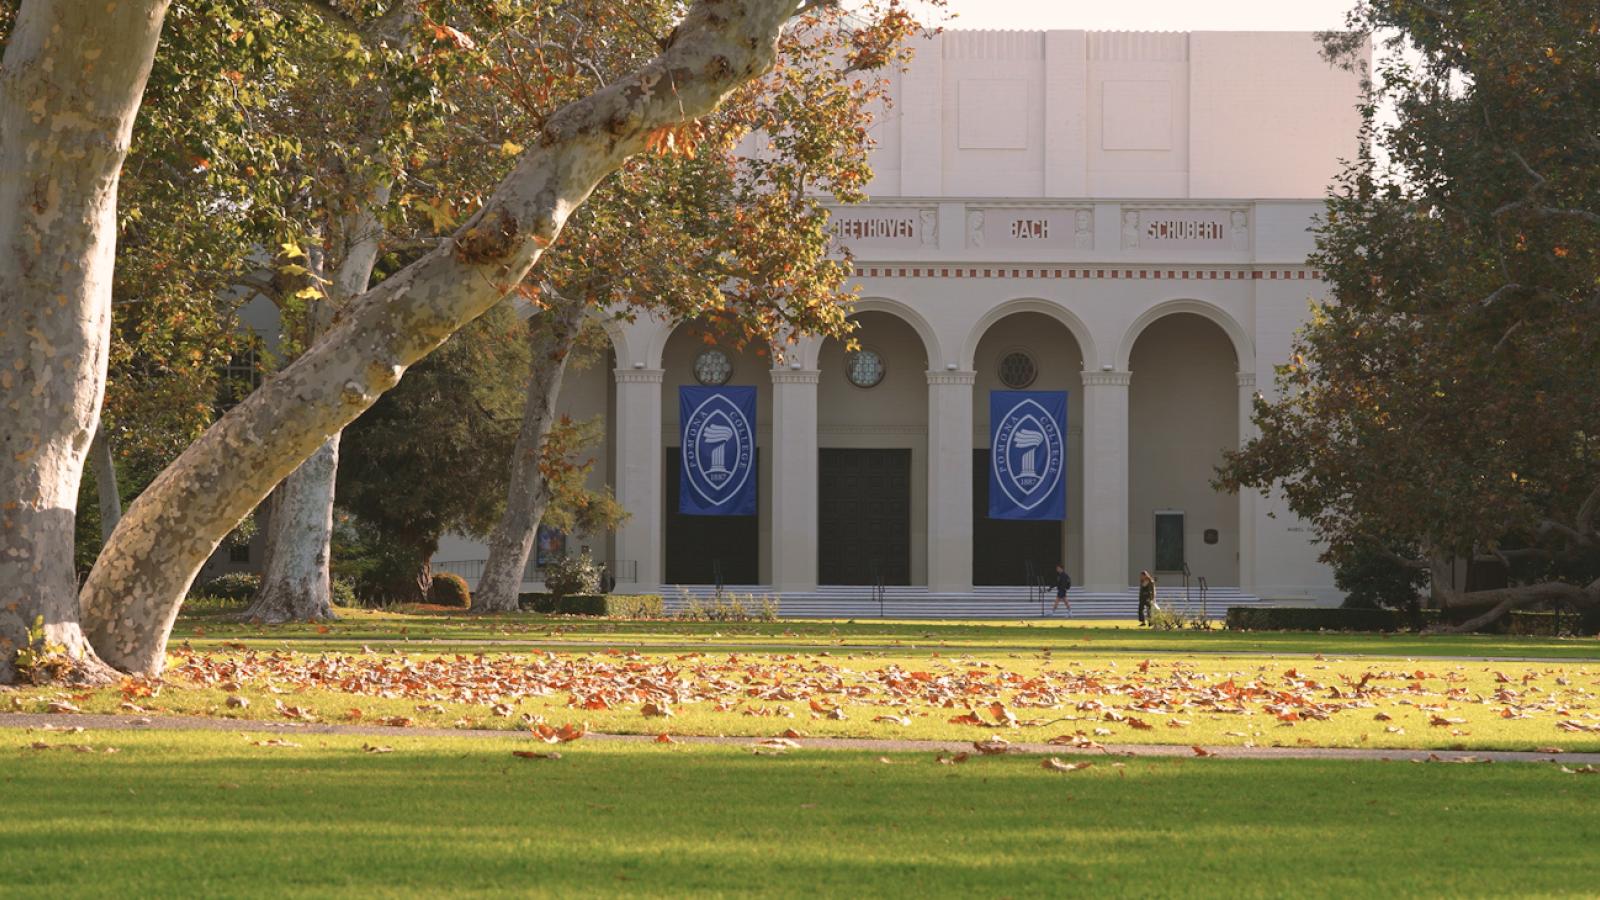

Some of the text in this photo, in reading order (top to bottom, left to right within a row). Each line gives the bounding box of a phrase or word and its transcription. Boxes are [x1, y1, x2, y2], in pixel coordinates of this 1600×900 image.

[832, 219, 915, 238] BEETHOVEN
[1009, 219, 1049, 239] BACH
[1147, 220, 1224, 239] SCHUBERT
[687, 410, 749, 468] POMONA COLLEGE
[997, 415, 1060, 473] POMONA COLLEGE
